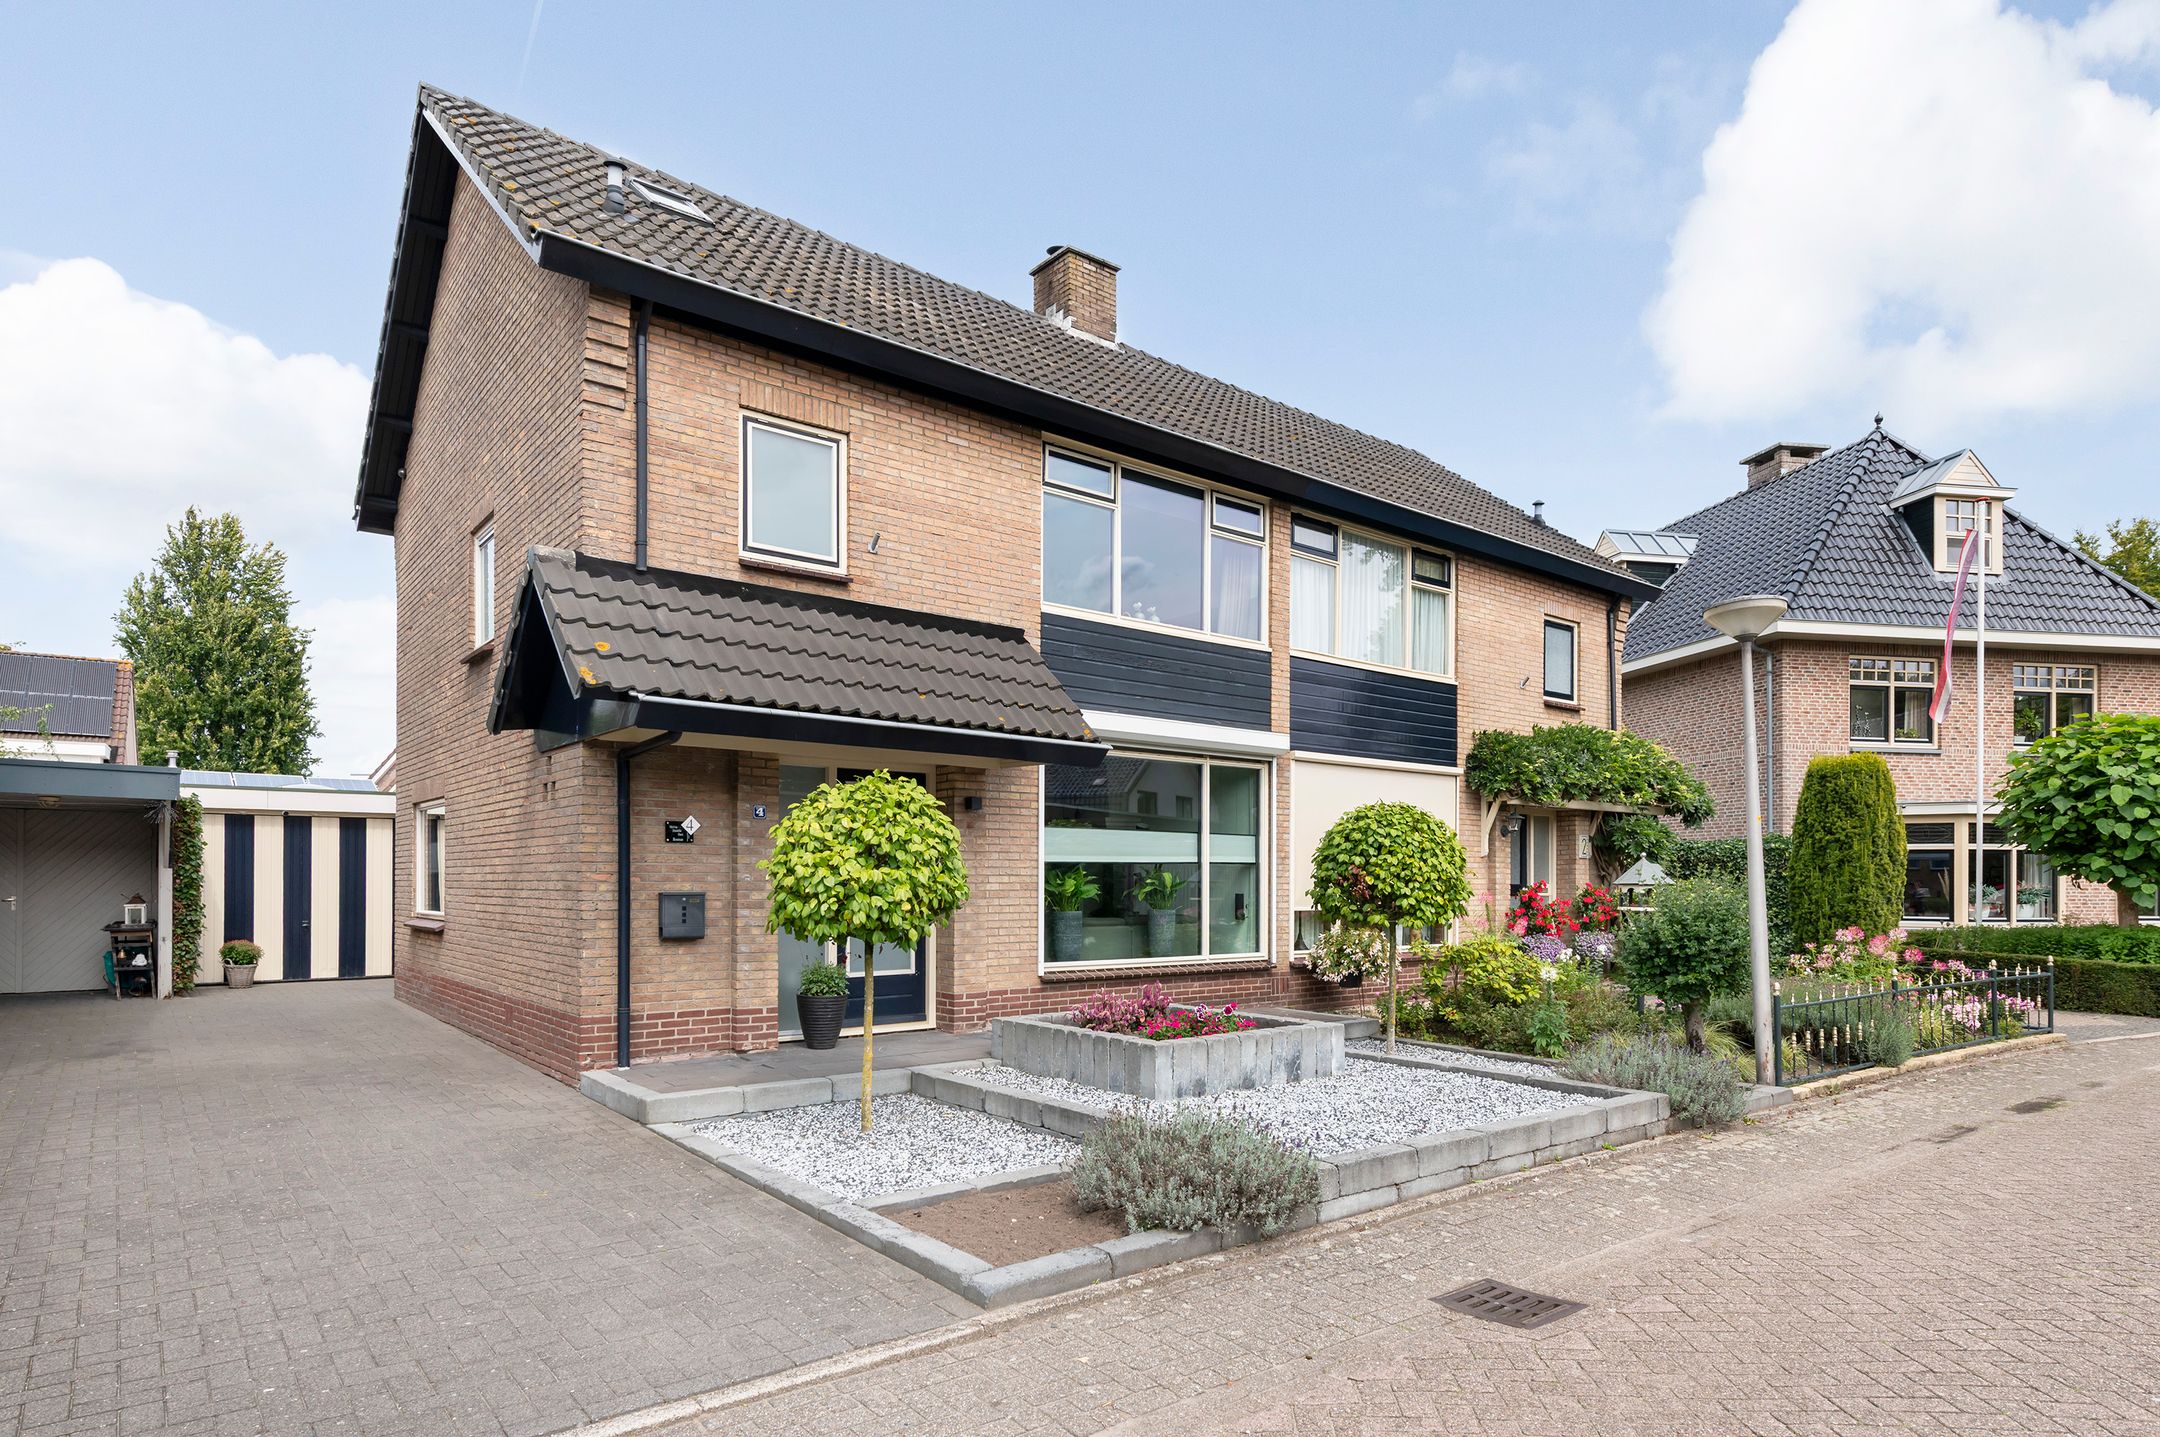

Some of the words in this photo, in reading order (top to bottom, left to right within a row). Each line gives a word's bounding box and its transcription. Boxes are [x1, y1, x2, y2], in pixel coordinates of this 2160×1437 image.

[755, 807, 764, 817] 4
[686, 818, 694, 831] 4
[1581, 838, 1587, 855] 2
